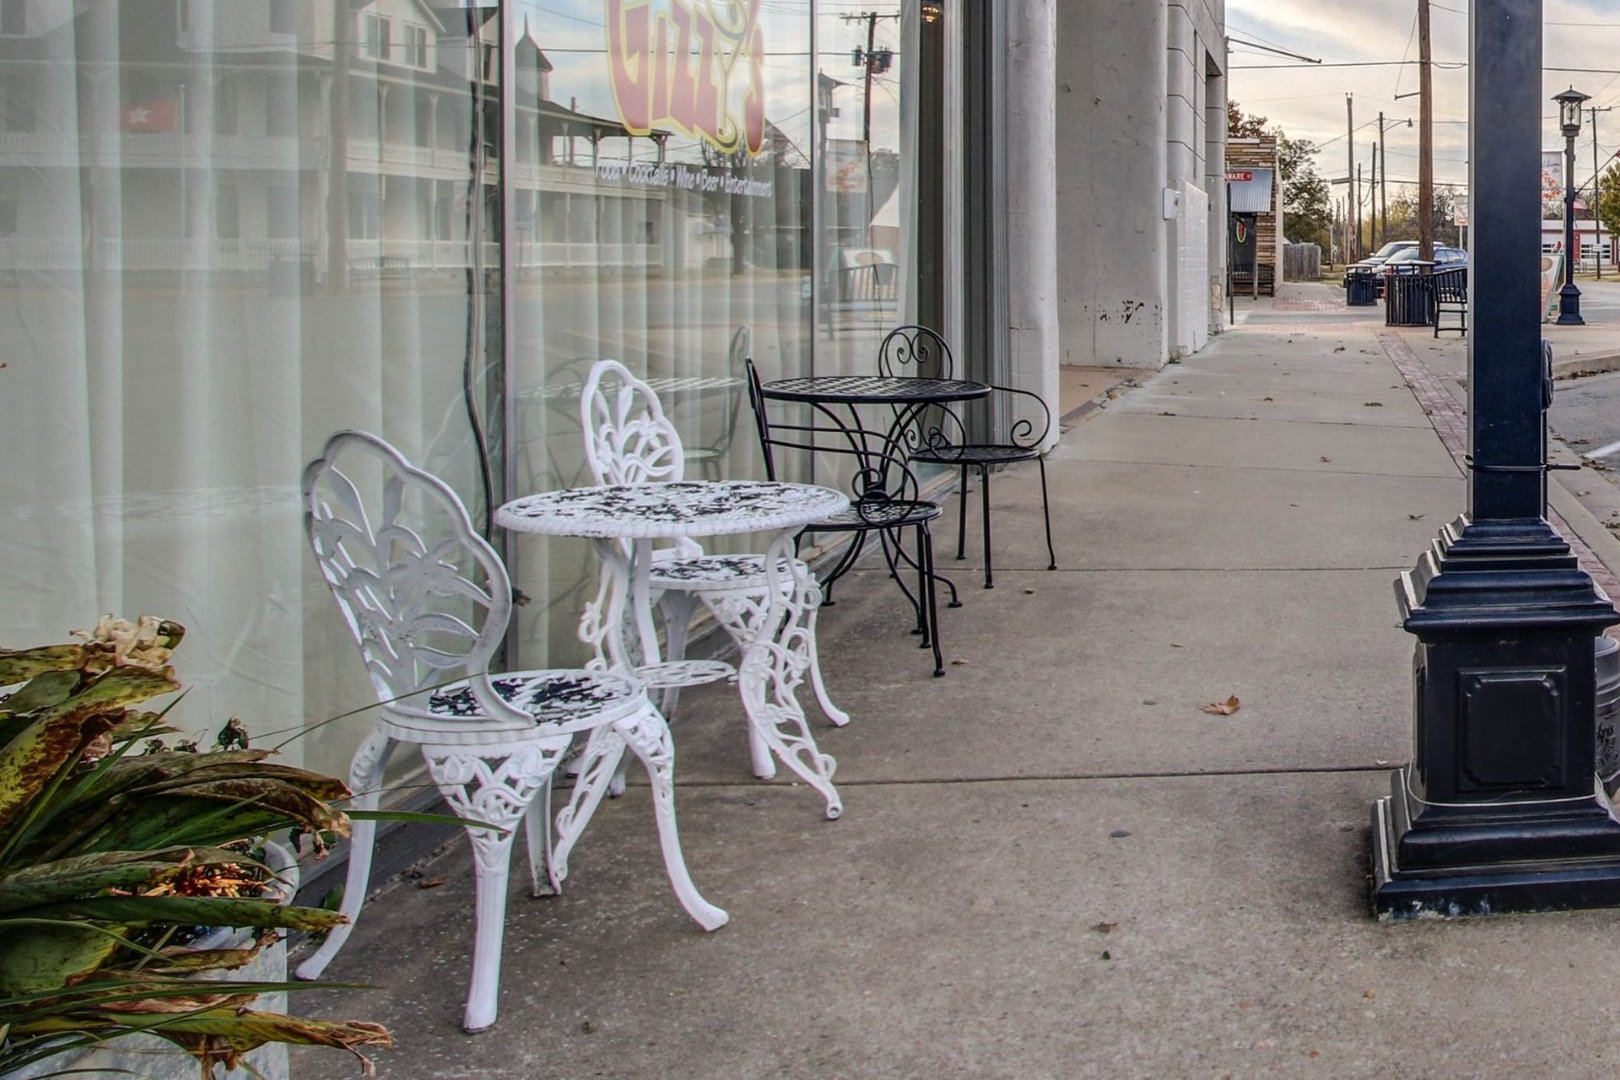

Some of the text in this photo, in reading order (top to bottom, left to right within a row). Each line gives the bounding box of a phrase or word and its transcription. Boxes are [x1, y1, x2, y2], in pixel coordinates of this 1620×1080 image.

[629, 162, 669, 187] Cocktails
[676, 165, 695, 190] Wine
[701, 168, 719, 192] Beer
